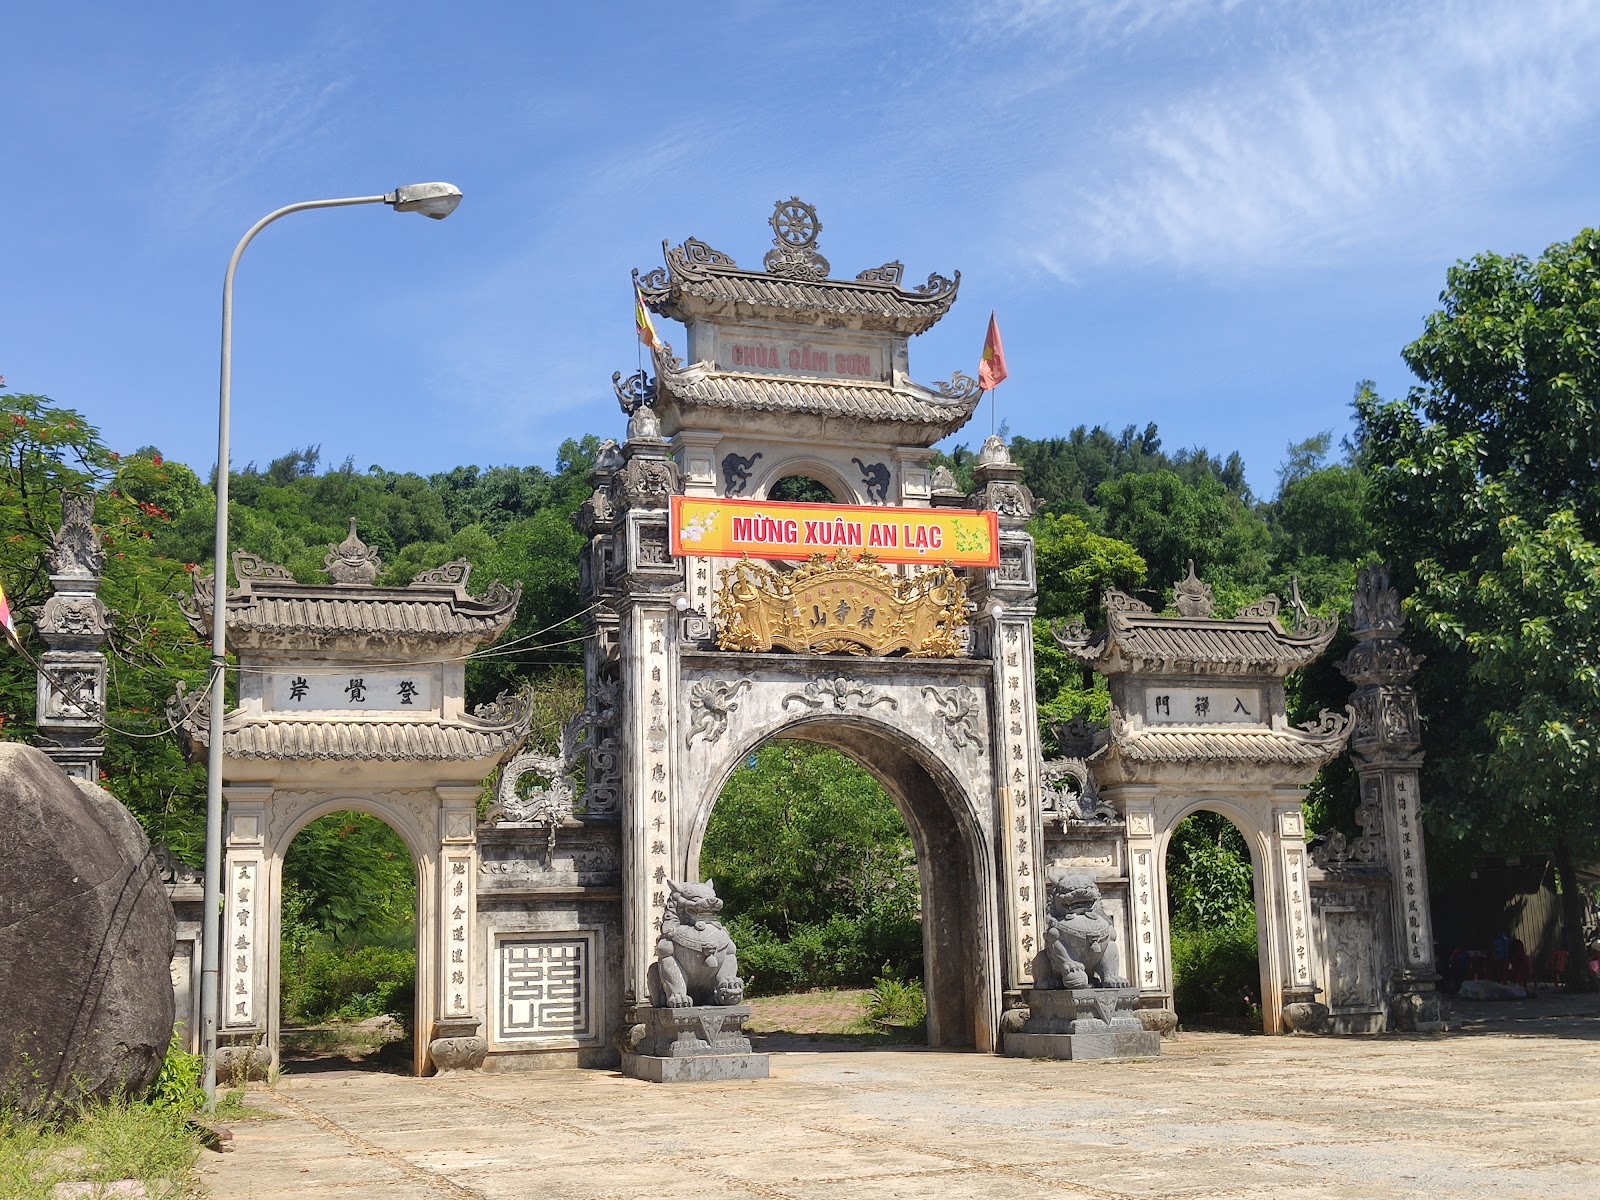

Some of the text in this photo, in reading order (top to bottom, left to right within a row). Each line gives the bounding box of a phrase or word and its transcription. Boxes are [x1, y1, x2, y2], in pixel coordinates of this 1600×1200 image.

[731, 343, 781, 369] CHÙA
[835, 352, 872, 376] SƠN
[733, 514, 942, 553] MỪNG XUÂN AN LẠC
